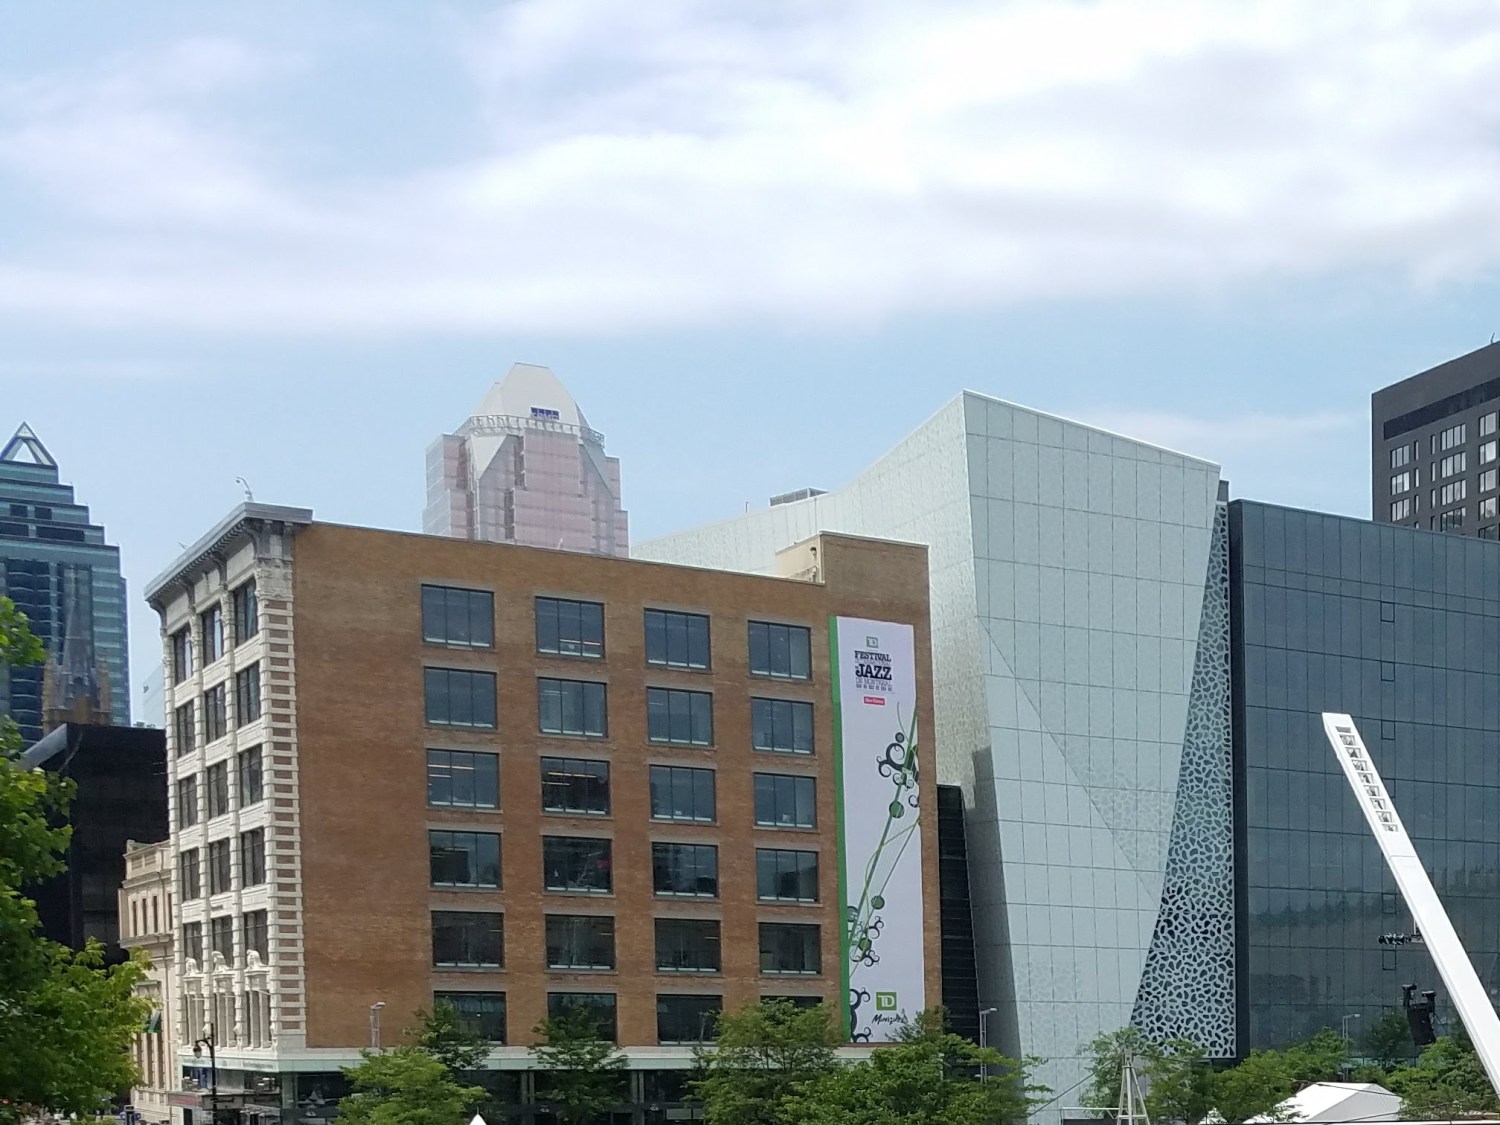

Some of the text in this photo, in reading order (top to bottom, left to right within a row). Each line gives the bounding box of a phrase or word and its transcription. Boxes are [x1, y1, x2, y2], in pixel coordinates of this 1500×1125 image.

[854, 650, 892, 662] FESTIVAL
[855, 663, 893, 681] JAZZ
[878, 995, 895, 1008] TD
